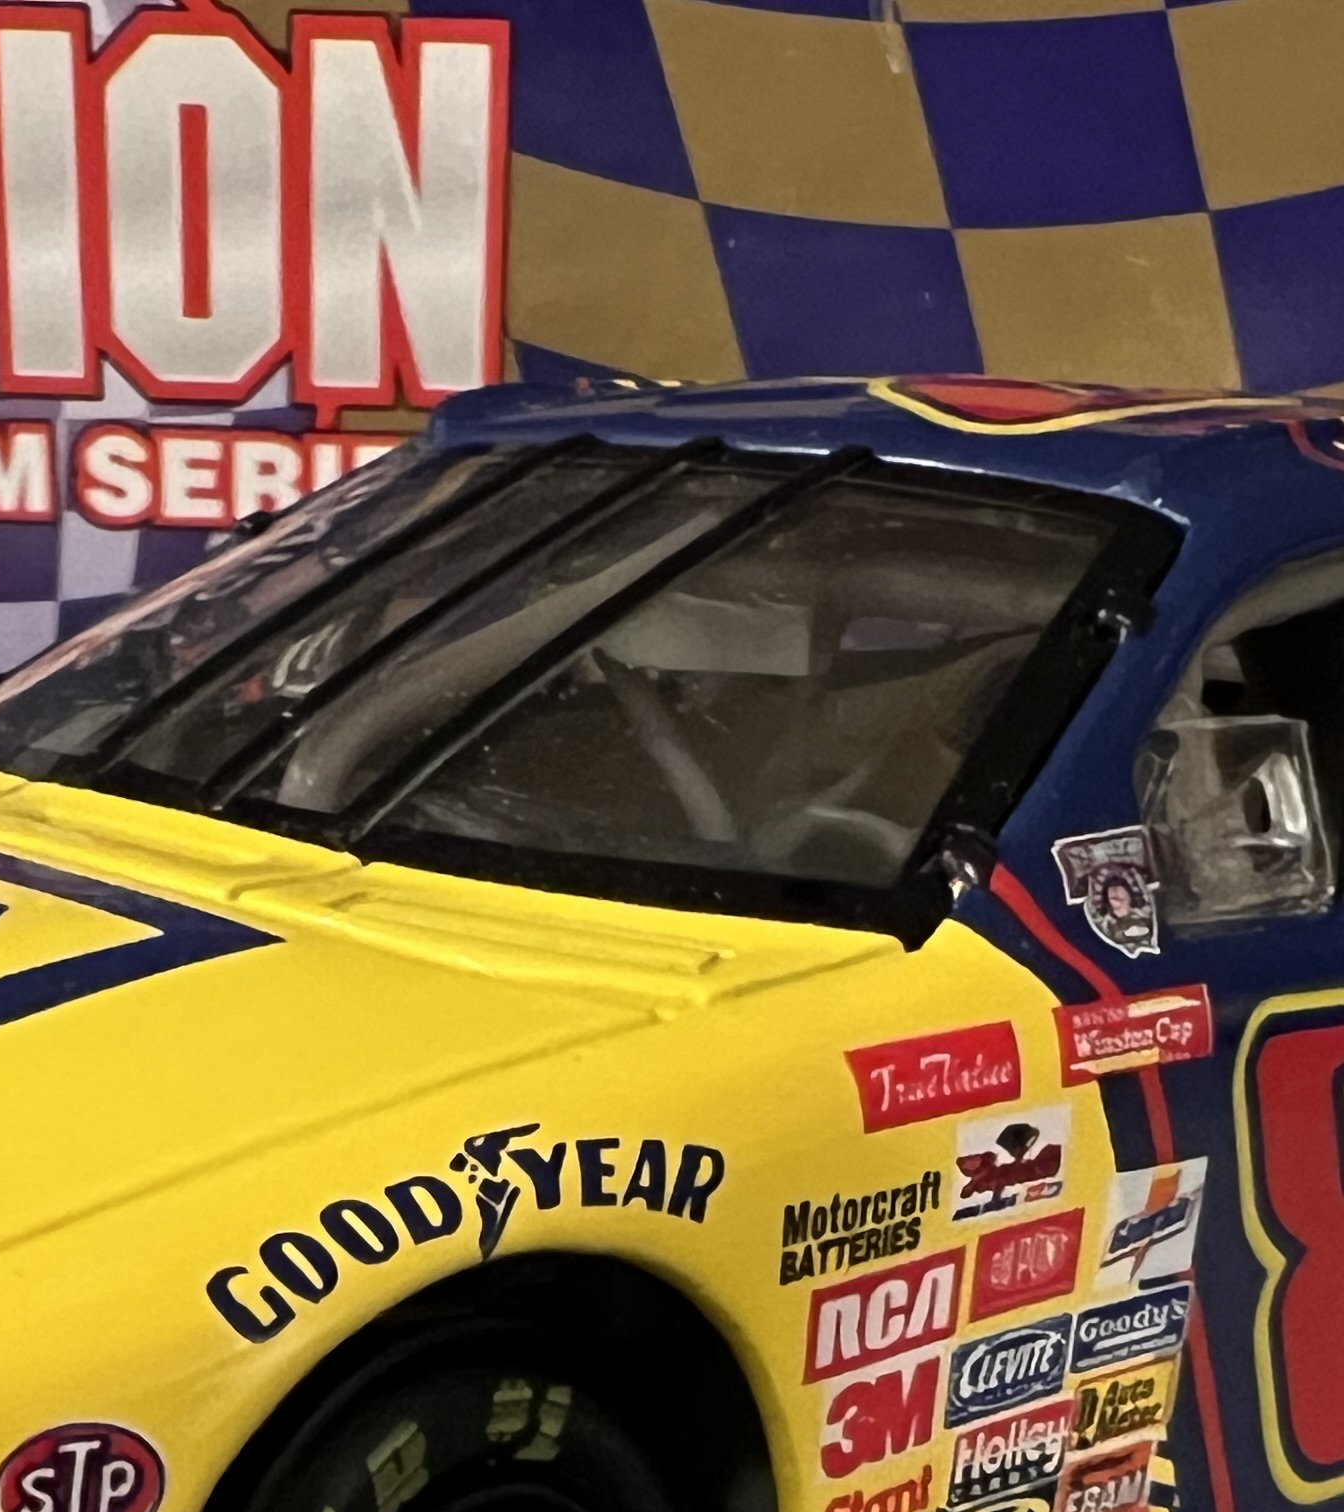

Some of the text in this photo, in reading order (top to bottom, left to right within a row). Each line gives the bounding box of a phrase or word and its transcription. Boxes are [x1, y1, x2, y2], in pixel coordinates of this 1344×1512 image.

[82, 434, 395, 520] SERI
[782, 1170, 941, 1248] Motorcraft
[778, 1216, 922, 1286] BATTERIES
[815, 1263, 955, 1369] RCA
[820, 1356, 941, 1479] 3M
[954, 1415, 1071, 1484] Holley
